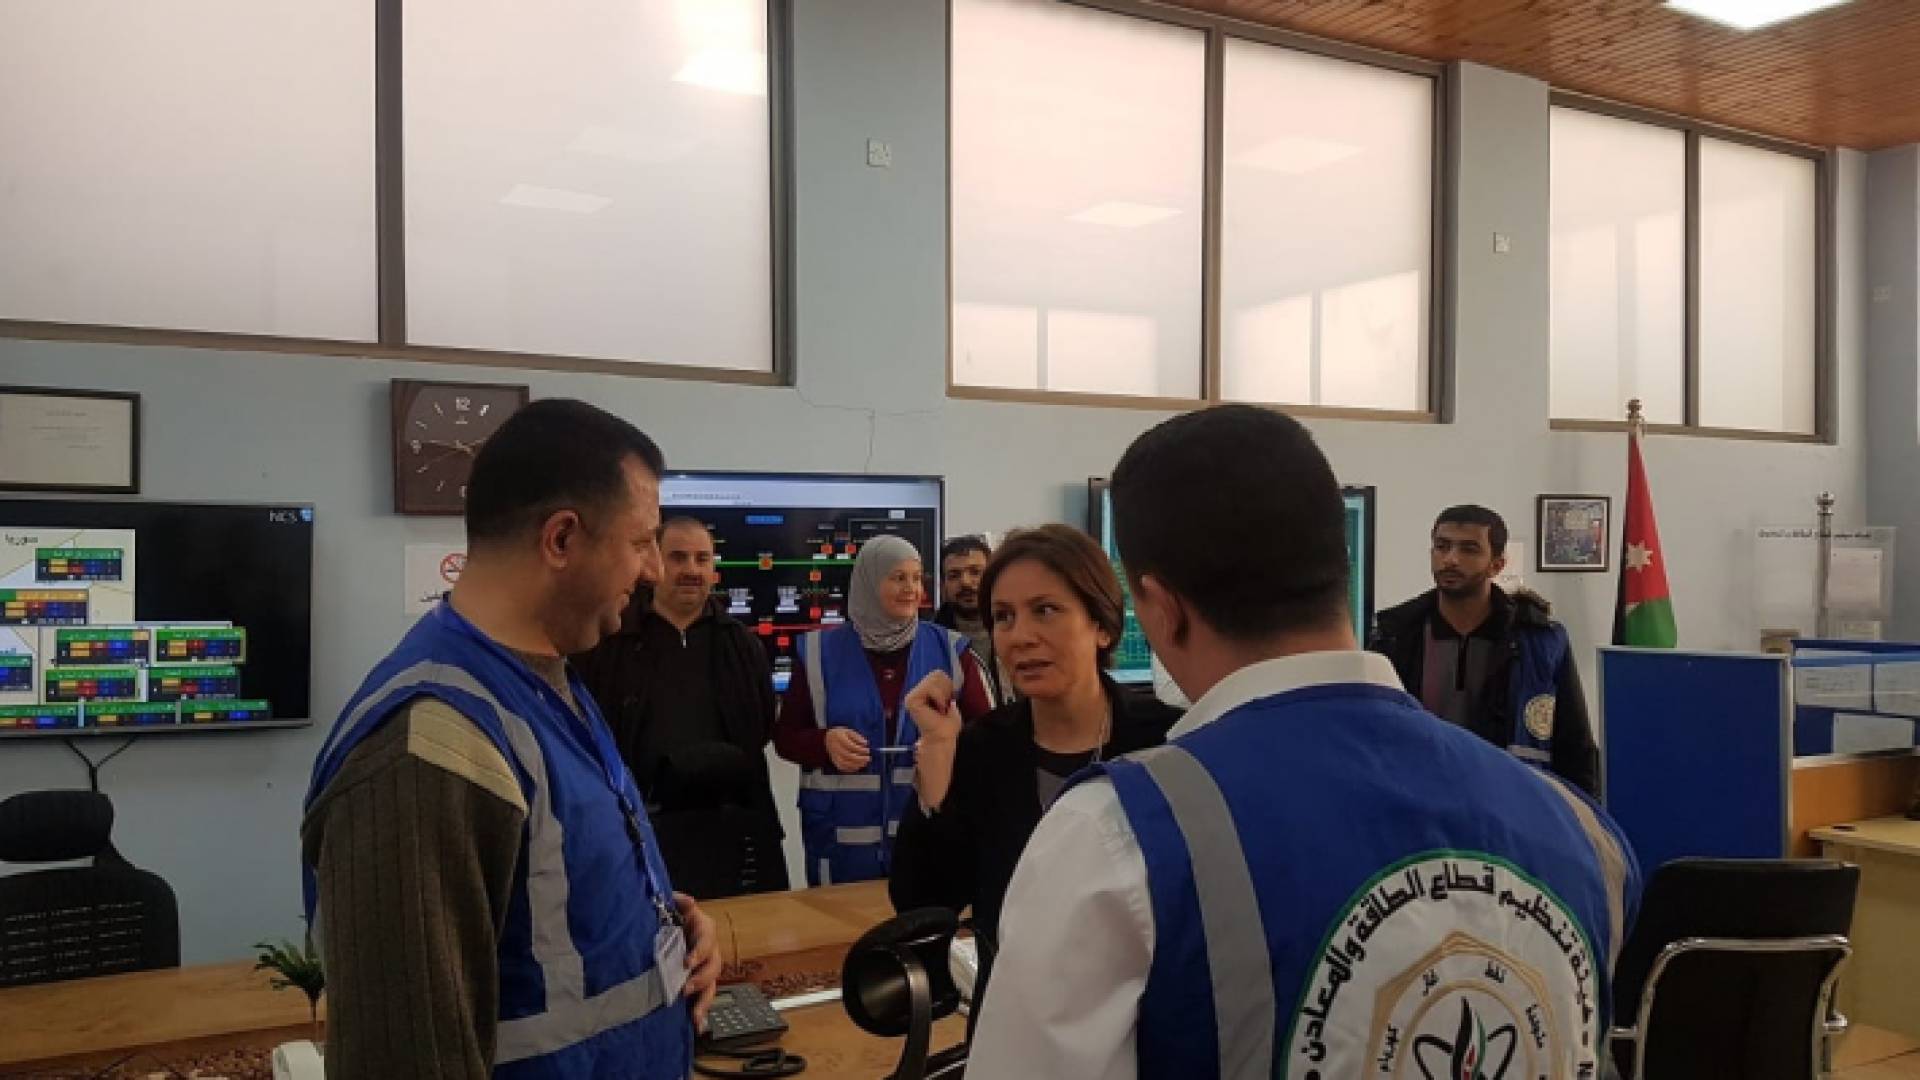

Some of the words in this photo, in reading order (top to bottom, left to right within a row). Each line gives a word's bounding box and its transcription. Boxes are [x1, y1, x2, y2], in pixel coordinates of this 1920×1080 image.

[1347, 868, 1426, 942] الطاقة
[1430, 861, 1496, 900] قطاع
[1499, 889, 1579, 954] تنظيم
[1300, 936, 1367, 1062] والمعادن
